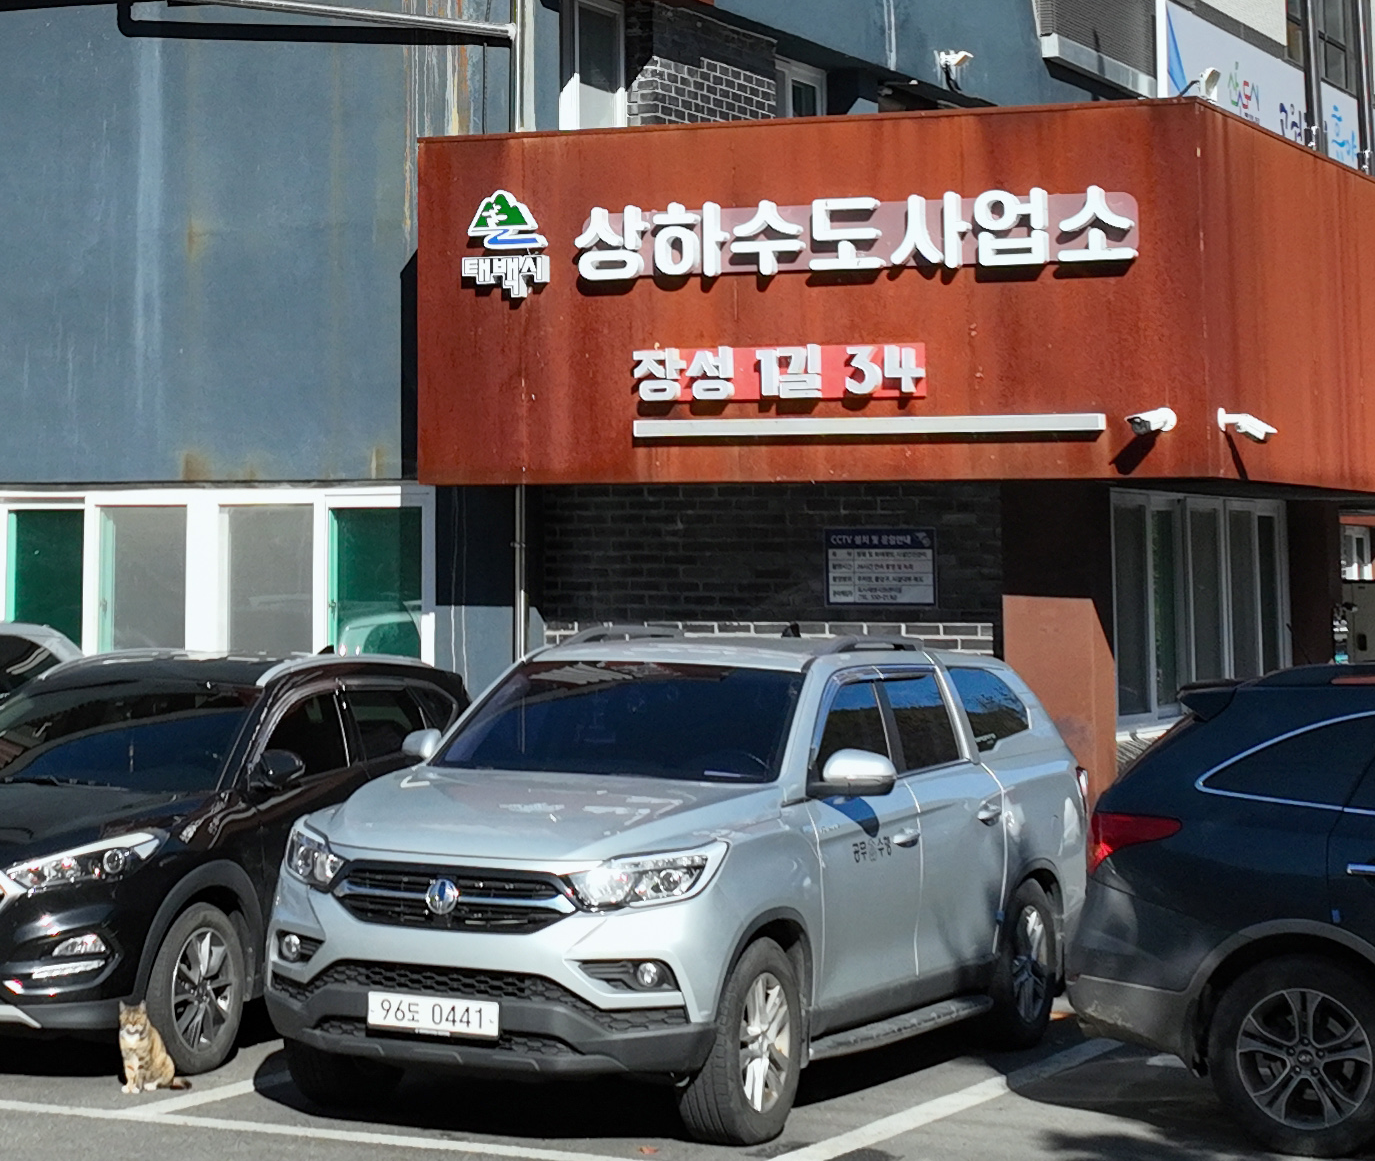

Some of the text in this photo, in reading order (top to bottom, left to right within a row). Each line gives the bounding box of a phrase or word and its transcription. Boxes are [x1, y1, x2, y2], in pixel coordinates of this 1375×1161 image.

[462, 185, 1139, 298] 태백시 상하수도사업소
[633, 343, 925, 401] 장성 1길 34
[381, 999, 482, 1029] 96도 0441
